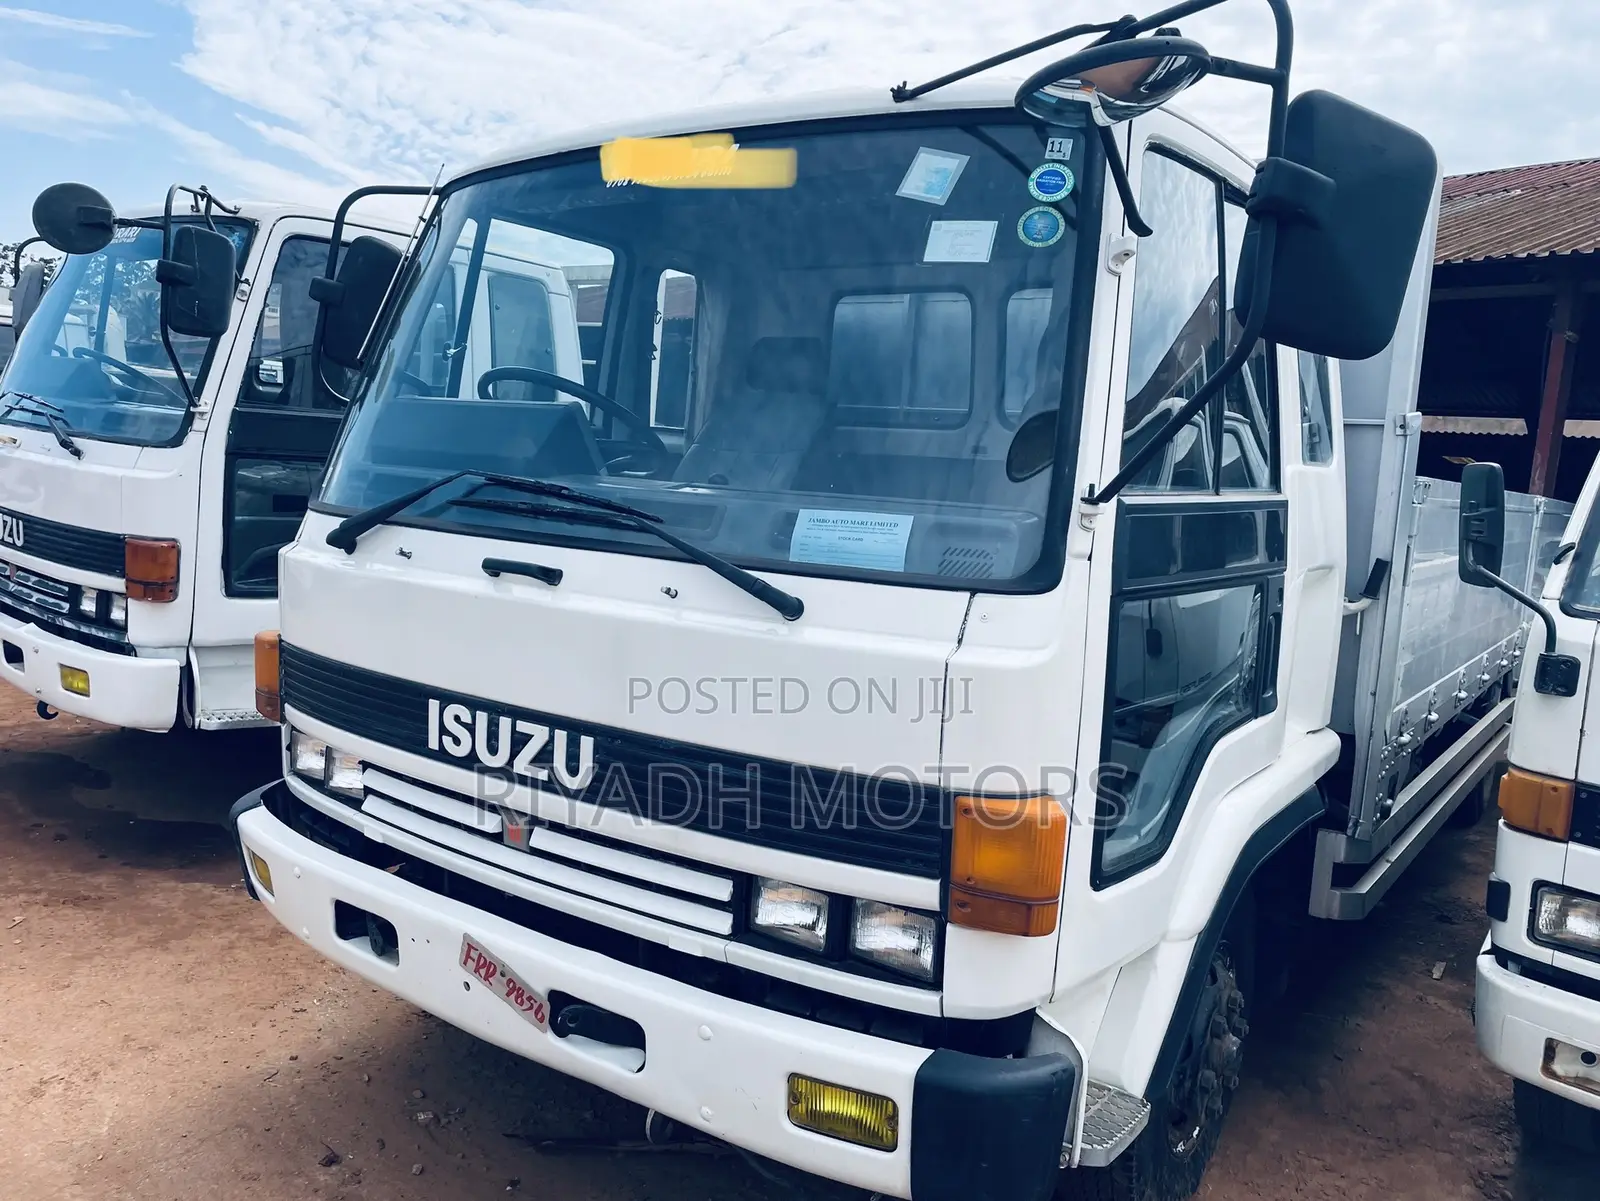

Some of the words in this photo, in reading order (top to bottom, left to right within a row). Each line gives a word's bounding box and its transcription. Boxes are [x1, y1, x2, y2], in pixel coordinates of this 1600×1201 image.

[1048, 139, 1063, 153] 11
[808, 517, 831, 525] JAMBO
[869, 521, 899, 529] LIMITED
[427, 699, 594, 790] ISUZU
[462, 942, 498, 986] FRR
[505, 977, 546, 1024] 9856
